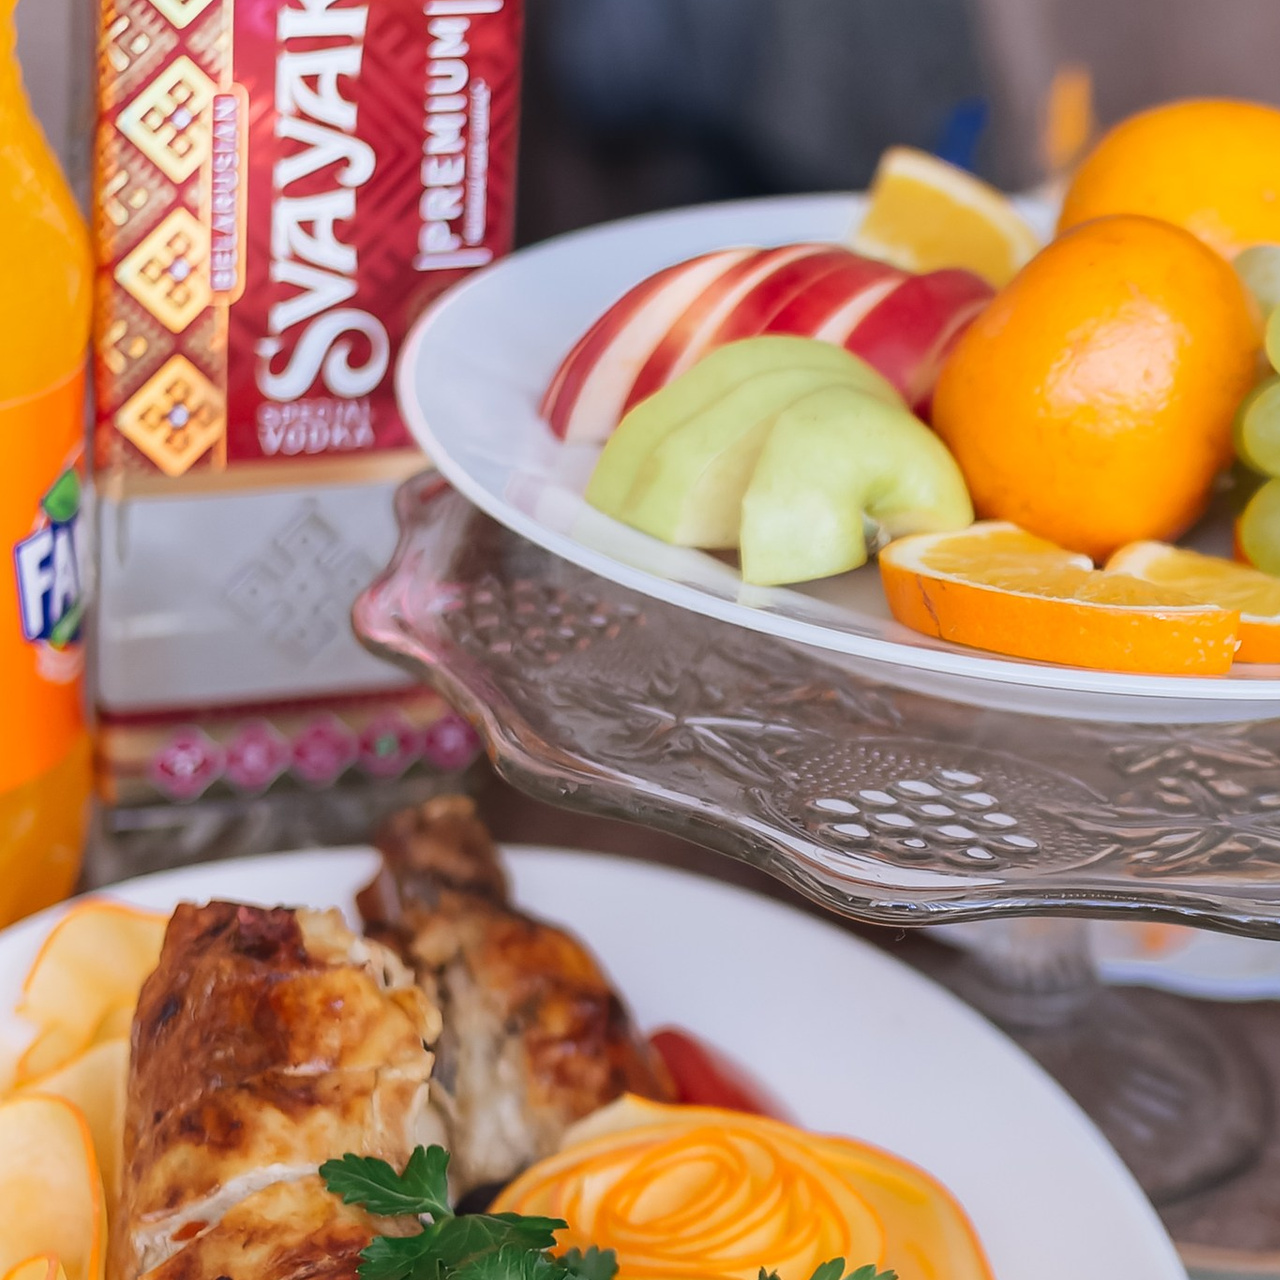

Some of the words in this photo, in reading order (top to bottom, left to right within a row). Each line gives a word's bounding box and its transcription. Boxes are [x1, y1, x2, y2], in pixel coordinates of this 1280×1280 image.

[210, 94, 240, 292] BELARUSIAN
[417, 16, 470, 254] PREMIUM
[258, 423, 375, 456] VODKA
